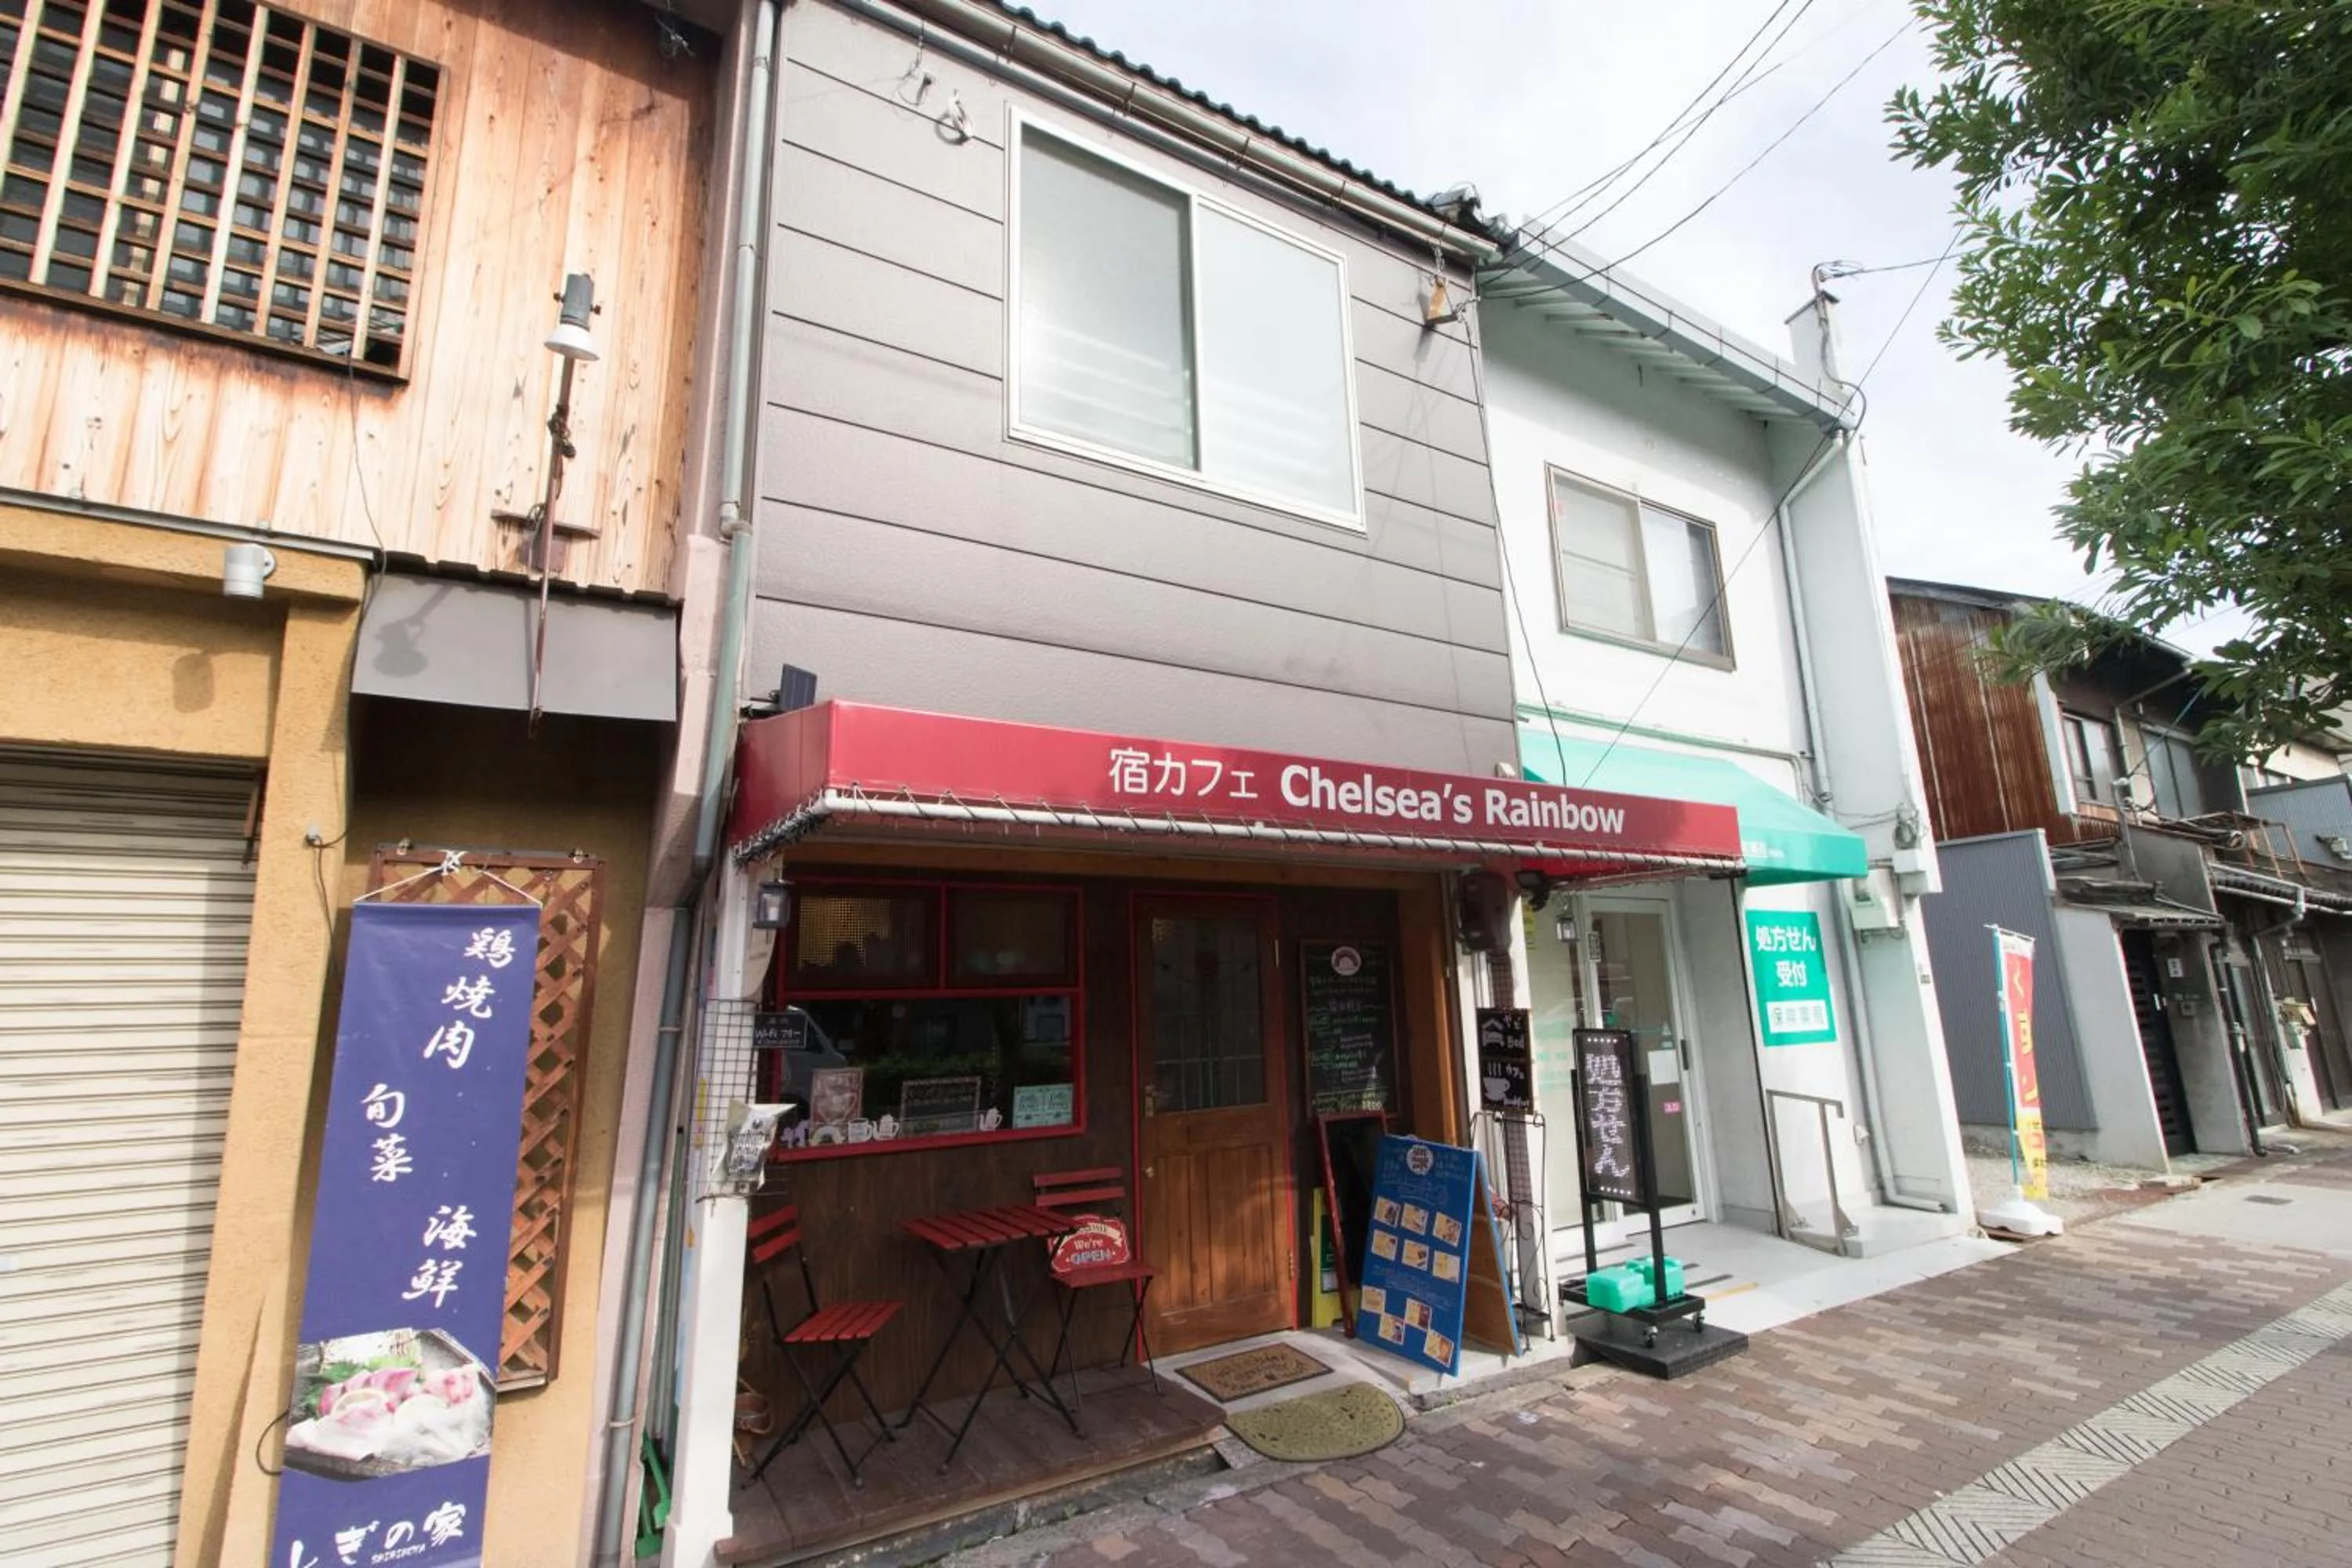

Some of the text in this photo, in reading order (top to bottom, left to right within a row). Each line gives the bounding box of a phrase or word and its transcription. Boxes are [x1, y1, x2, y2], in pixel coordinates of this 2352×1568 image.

[1109, 747, 1258, 798] 宿カフェ
[1280, 764, 1625, 834] Chelsea's Rainbow
[1755, 926, 1817, 952] 処方せん
[423, 927, 516, 1069] 鶏焼肉
[1776, 960, 1807, 987] 受付
[361, 1083, 413, 1182] 旬菜
[401, 1205, 477, 1308] 海鮮
[1070, 1248, 1112, 1266] OPEN
